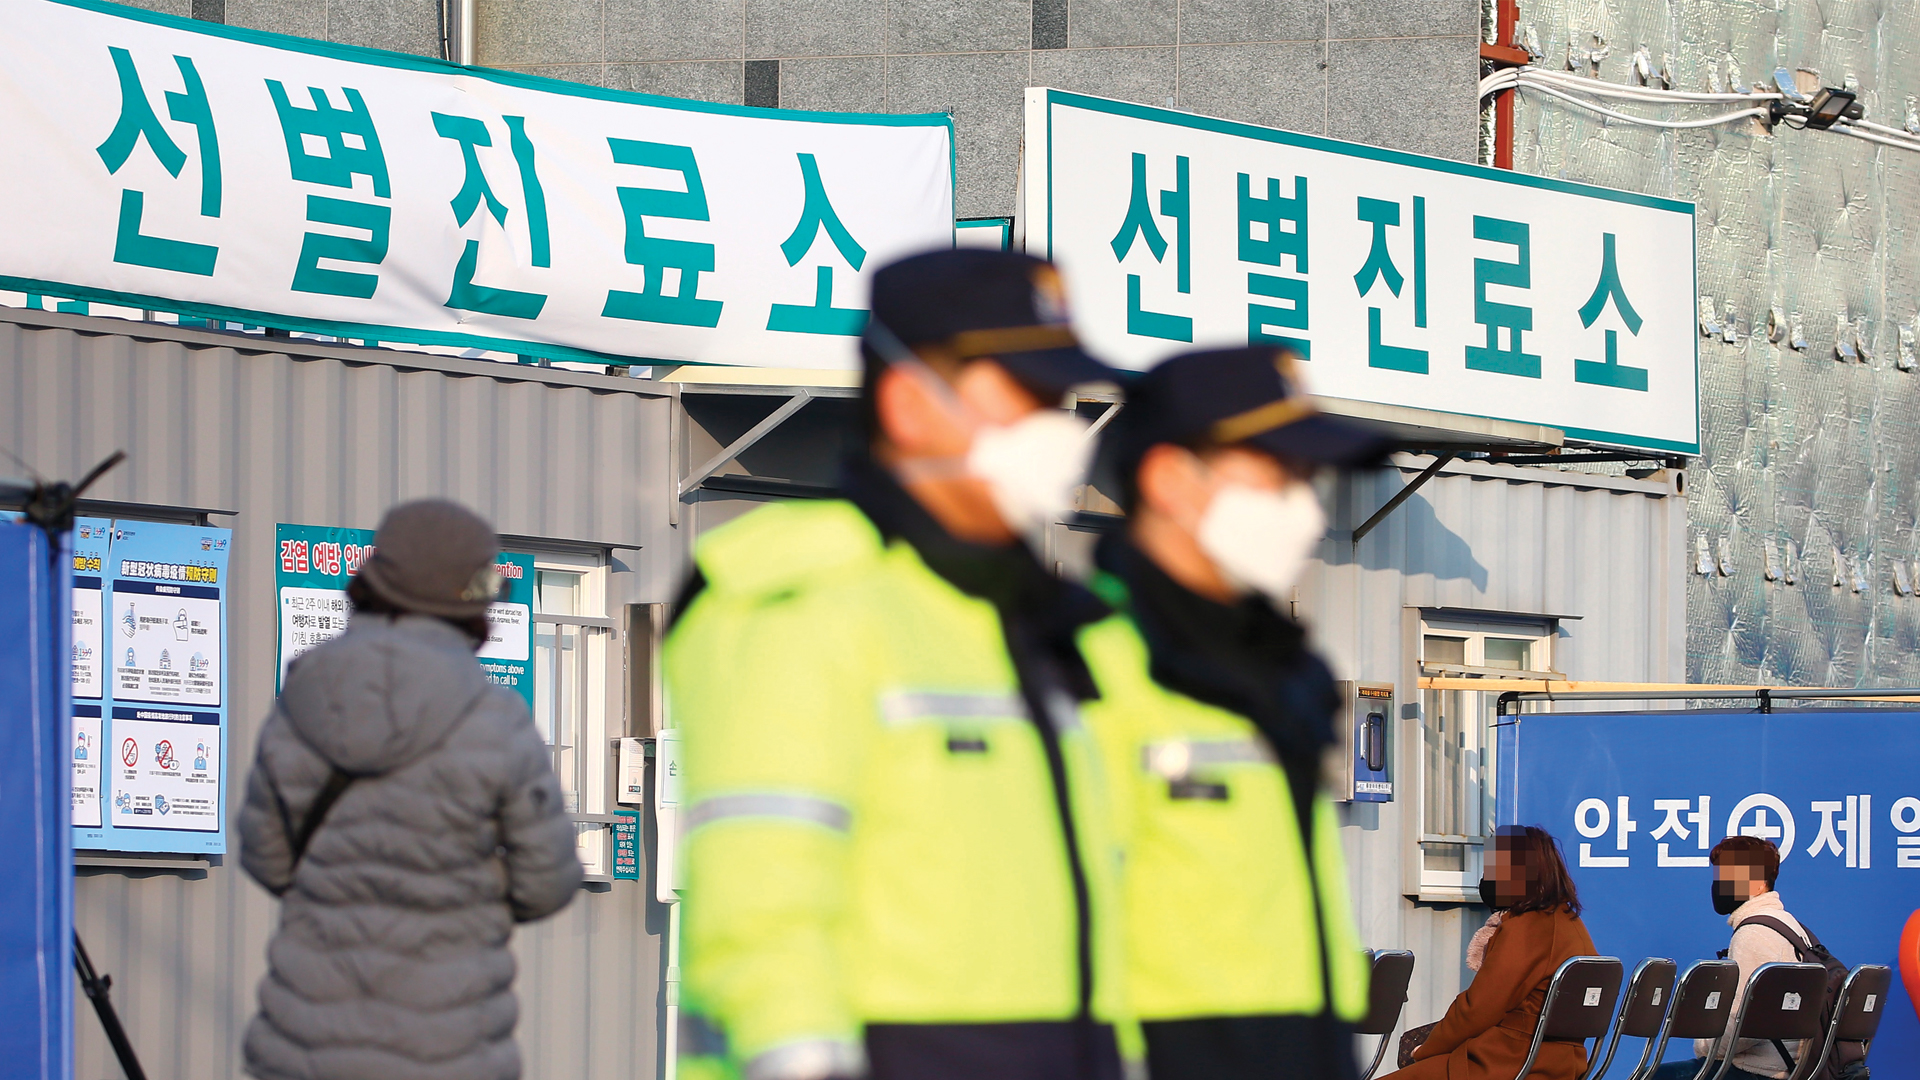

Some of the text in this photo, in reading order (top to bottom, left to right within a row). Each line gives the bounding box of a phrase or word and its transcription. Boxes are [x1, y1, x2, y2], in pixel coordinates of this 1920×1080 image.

[96, 46, 870, 336] 선별진료소
[1110, 152, 1648, 392] 선별진료소
[280, 539, 310, 574] 감염
[312, 541, 342, 576] 예방
[291, 596, 304, 611] 최근
[305, 597, 316, 611] 2주
[317, 598, 330, 612] 이내
[331, 599, 344, 613] 해외
[292, 614, 317, 628] 여행자로
[318, 615, 331, 629] 발열
[332, 616, 345, 630] 또는
[493, 674, 499, 684] to
[500, 674, 510, 685] call
[510, 675, 518, 686] to
[507, 664, 524, 675] above
[1573, 795, 1712, 868] 안전
